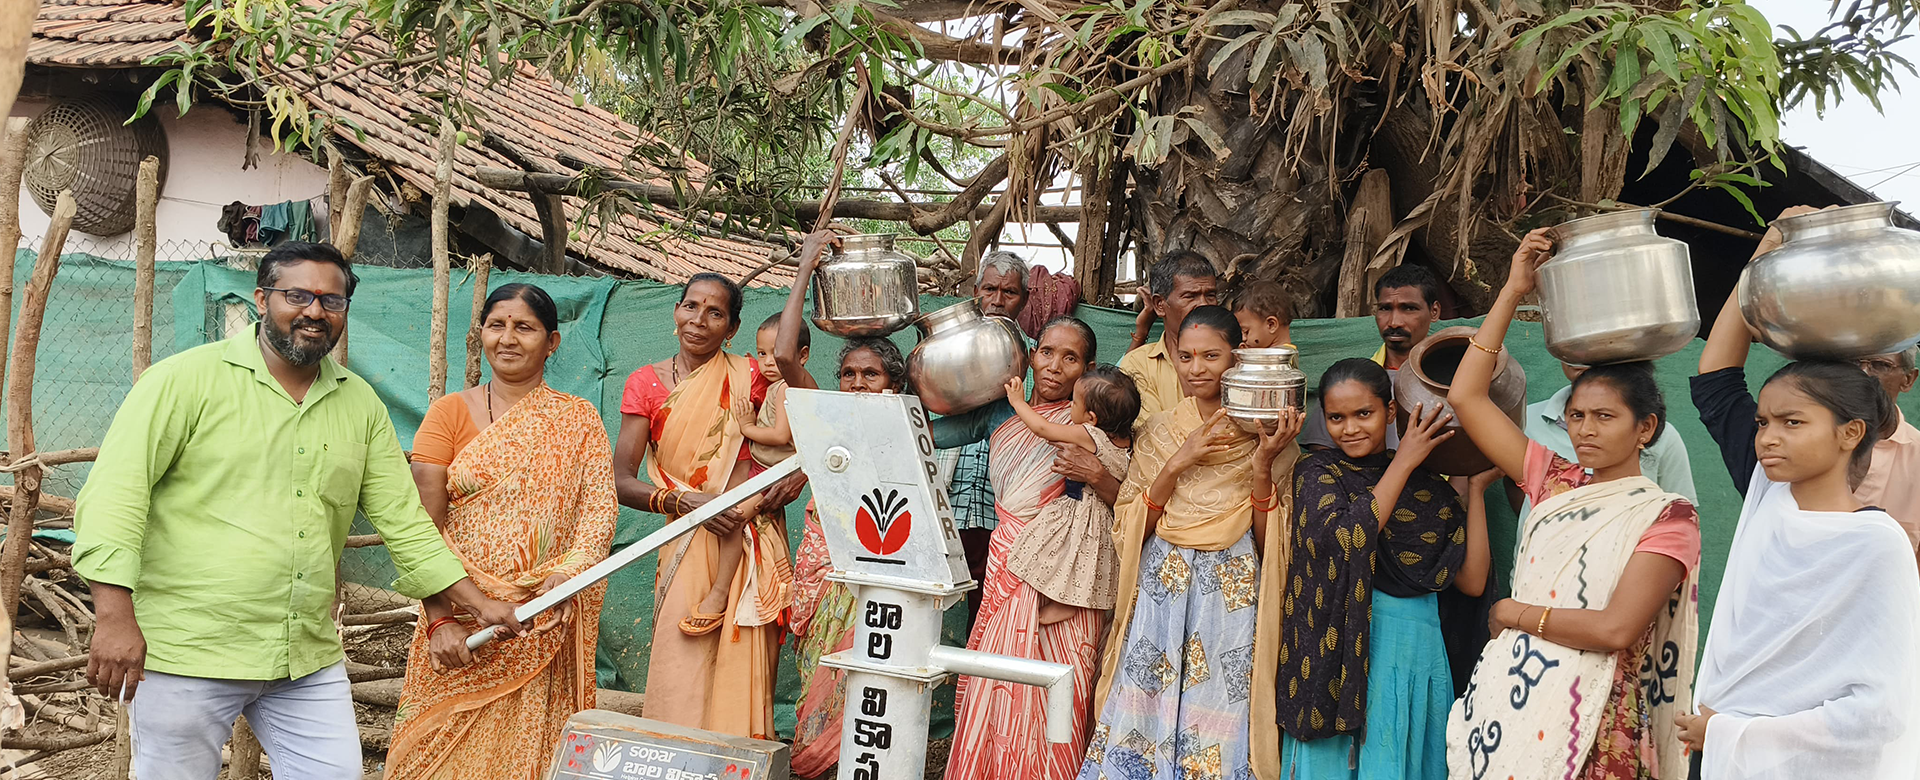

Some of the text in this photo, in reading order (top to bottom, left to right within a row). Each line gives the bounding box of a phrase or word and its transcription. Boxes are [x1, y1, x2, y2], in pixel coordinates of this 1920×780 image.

[909, 406, 957, 541] SOPAR
[865, 600, 903, 660] బాల
[622, 761, 663, 779] బాల
[629, 745, 677, 763] sopar
